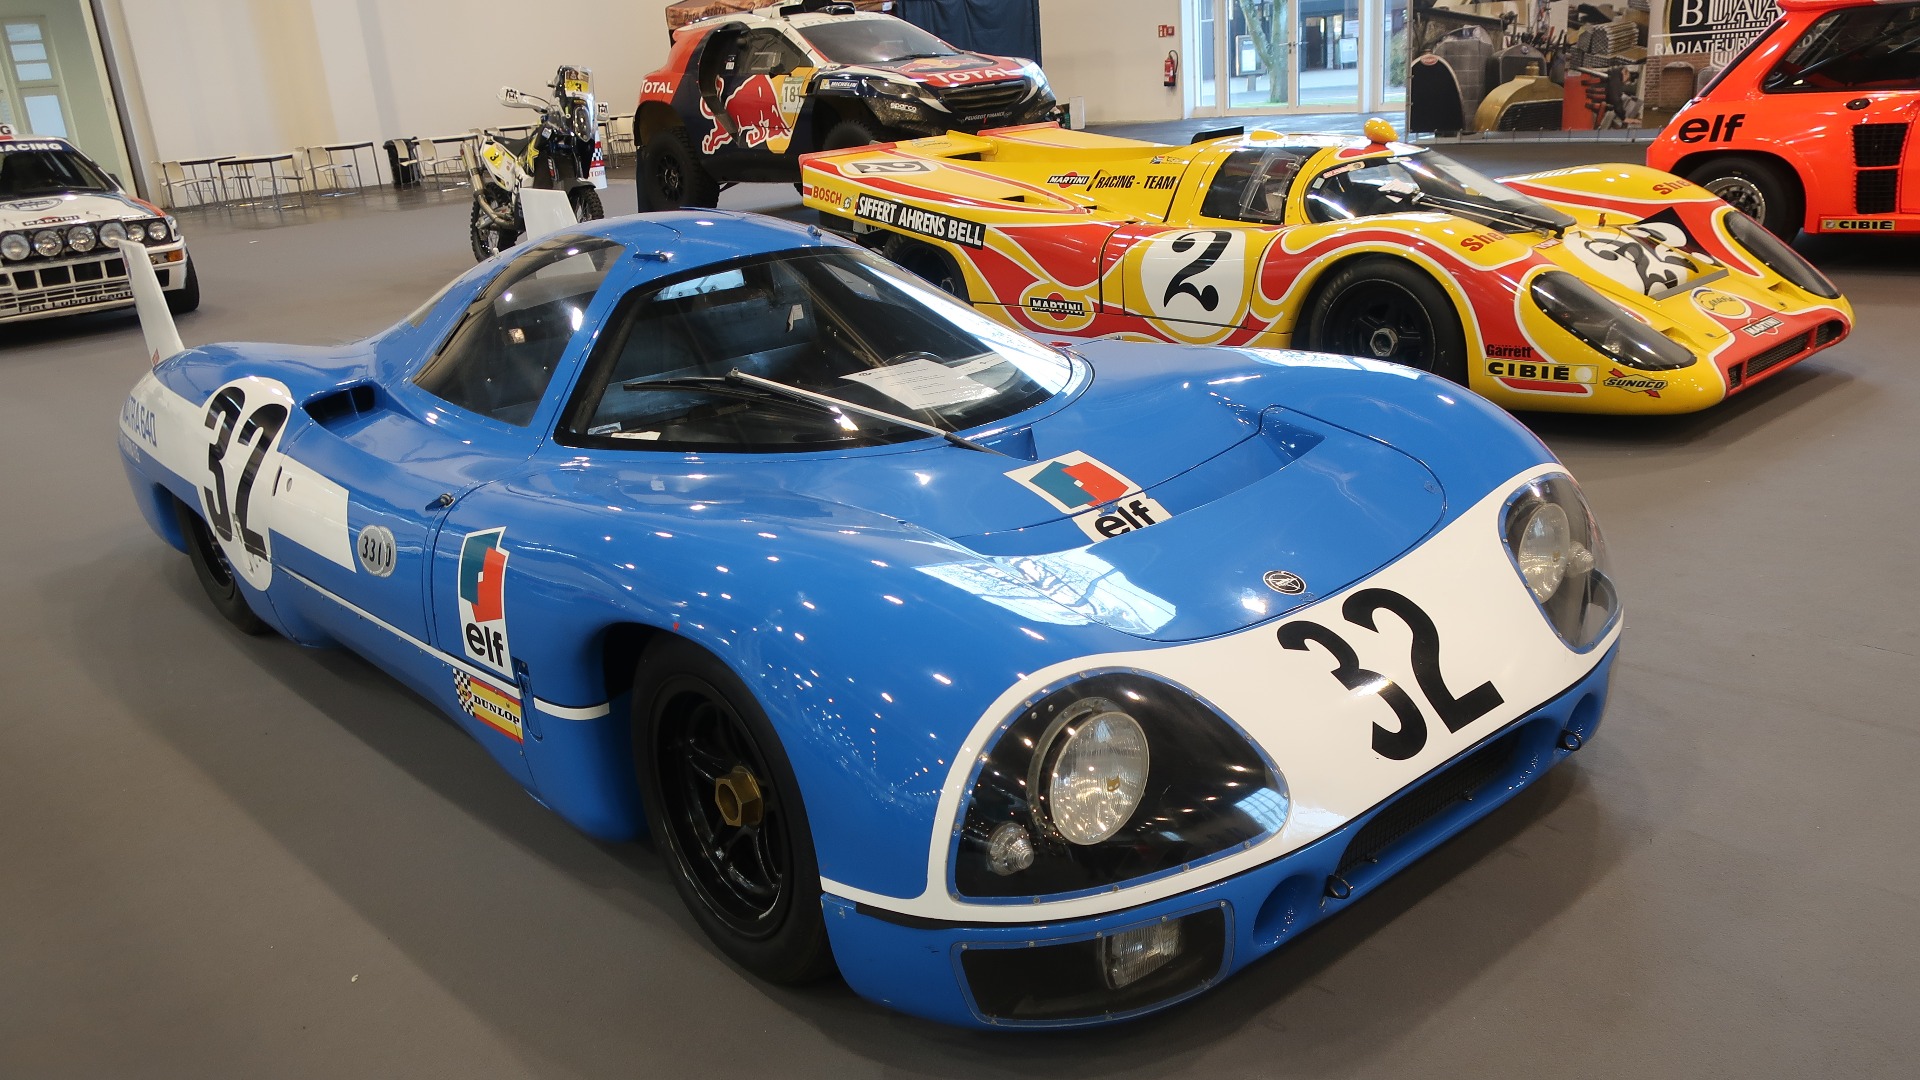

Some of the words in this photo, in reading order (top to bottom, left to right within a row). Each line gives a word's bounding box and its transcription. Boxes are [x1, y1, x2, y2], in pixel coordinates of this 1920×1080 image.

[1678, 0, 1785, 28] BLAA
[926, 67, 1018, 84] TOTAL
[641, 79, 674, 94] TOTAL
[783, 86, 801, 103] 181
[890, 102, 917, 113] sparco
[964, 113, 987, 121] PEUGEOT
[0, 125, 11, 135] G
[1678, 113, 1746, 144] elf
[1049, 175, 1090, 185] MARTINI
[1095, 174, 1136, 189] RACING
[1143, 175, 1177, 190] TEAM
[812, 185, 843, 206] BOSCH
[24, 215, 80, 226] MARTINI
[857, 195, 898, 224] SIFFERT
[898, 206, 947, 237] AHRENS
[947, 219, 983, 247] BELL
[1164, 230, 1233, 312] 2
[19, 303, 47, 313] Fiat
[1031, 298, 1084, 315] MARTINI
[1746, 316, 1781, 337] MARTINI
[1486, 344, 1532, 358] Garrett
[1488, 361, 1570, 381] CIBIÉ
[1606, 377, 1665, 389] SUNOCO
[140, 404, 158, 448] 640
[204, 386, 288, 563] 32
[1094, 499, 1157, 539] elf
[466, 622, 504, 668] elf
[1276, 587, 1505, 761] 32
[473, 694, 520, 725] DUNLOP
